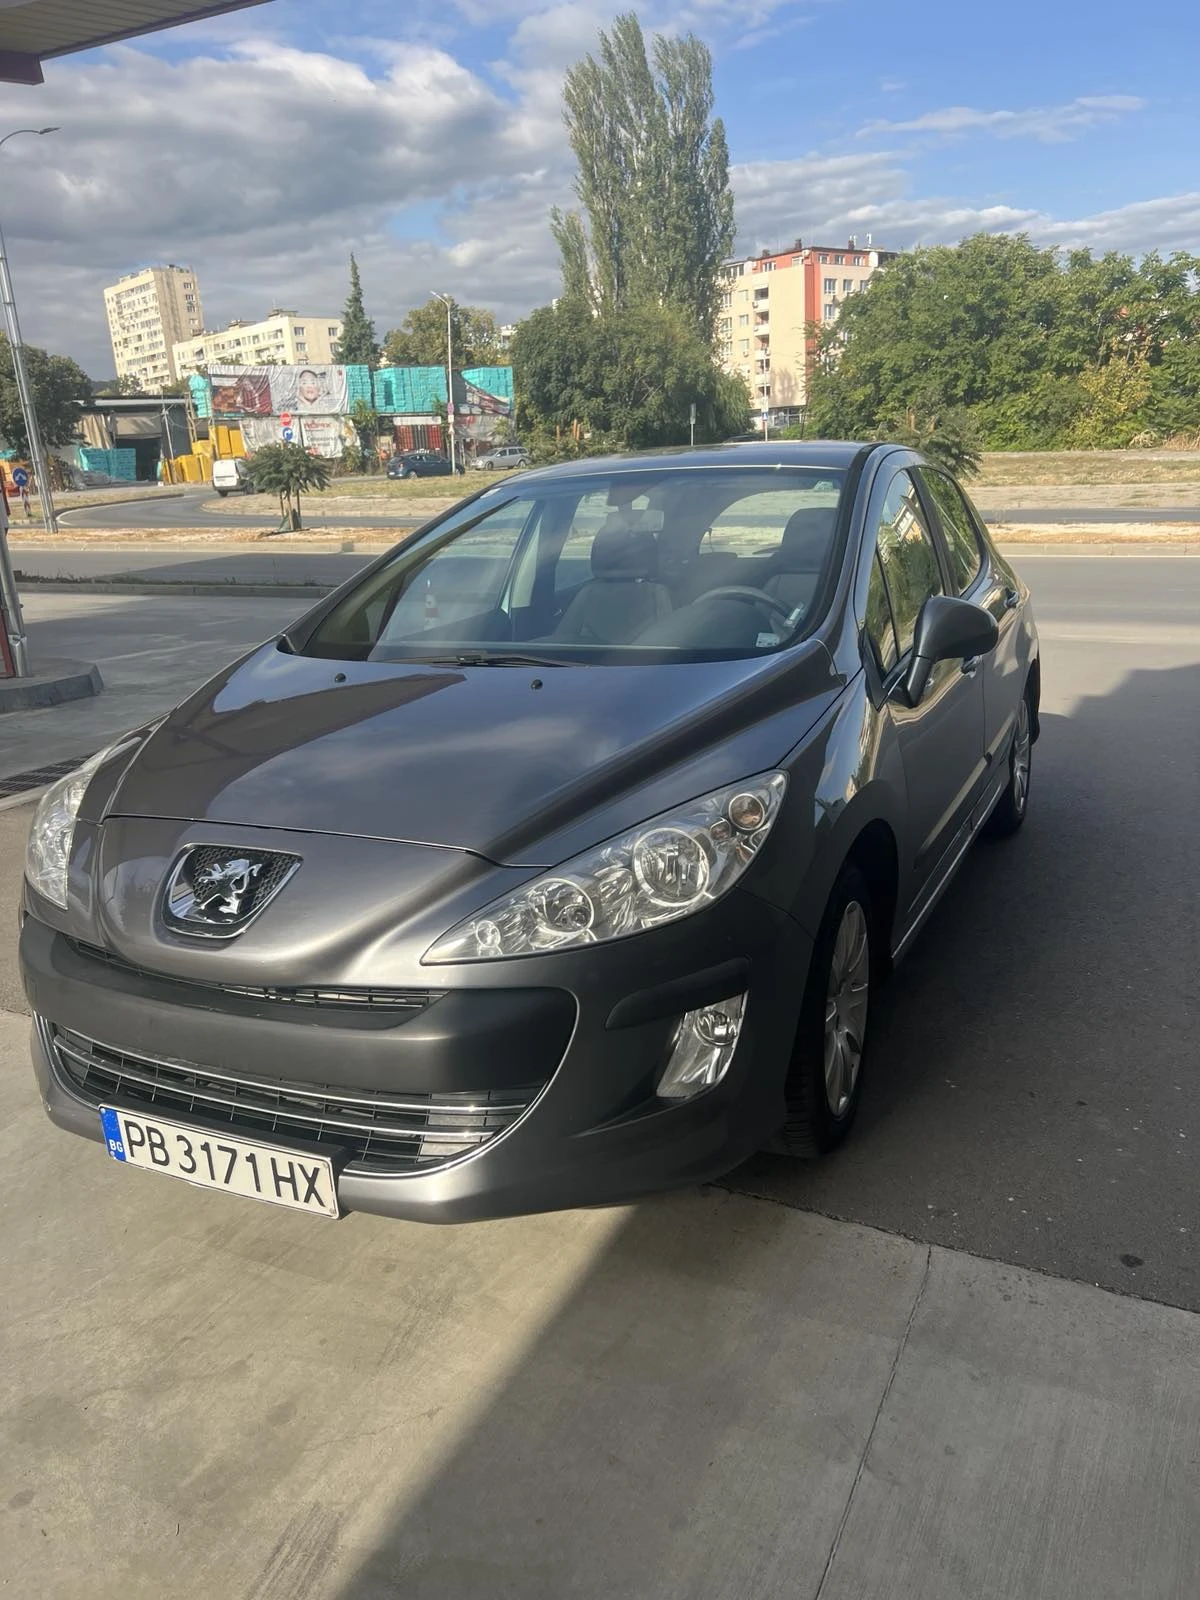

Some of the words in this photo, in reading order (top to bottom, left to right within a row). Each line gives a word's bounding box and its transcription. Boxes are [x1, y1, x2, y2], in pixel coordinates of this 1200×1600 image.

[109, 1139, 124, 1153] BG
[123, 1120, 170, 1166] PB
[176, 1135, 262, 1192] 3171
[270, 1157, 326, 1207] HX
